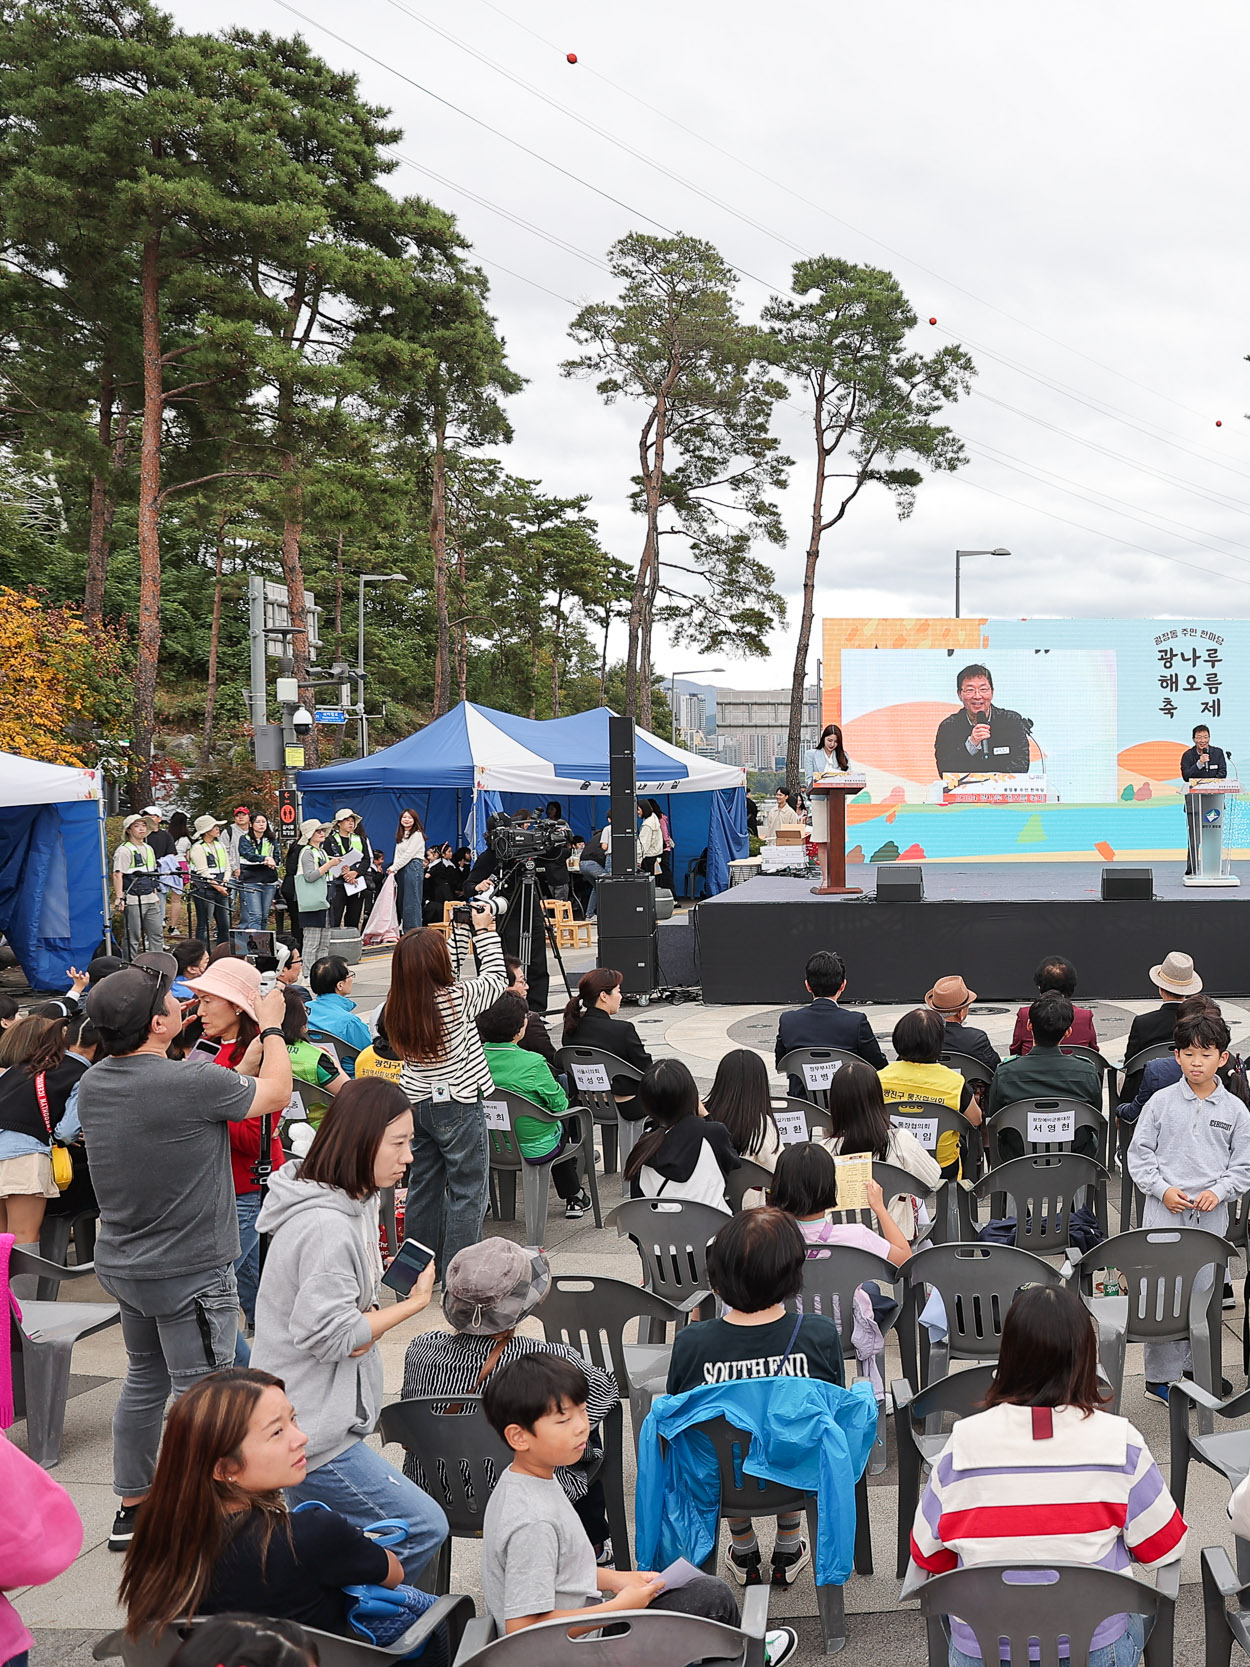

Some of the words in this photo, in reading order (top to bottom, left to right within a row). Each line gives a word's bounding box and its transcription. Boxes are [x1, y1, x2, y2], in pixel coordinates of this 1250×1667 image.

[1157, 647, 1223, 669] 광나루
[1157, 672, 1223, 694] 해오름
[884, 1089, 905, 1100] 광진구
[702, 1358, 766, 1386] SOUTH
[767, 1353, 810, 1378] END
